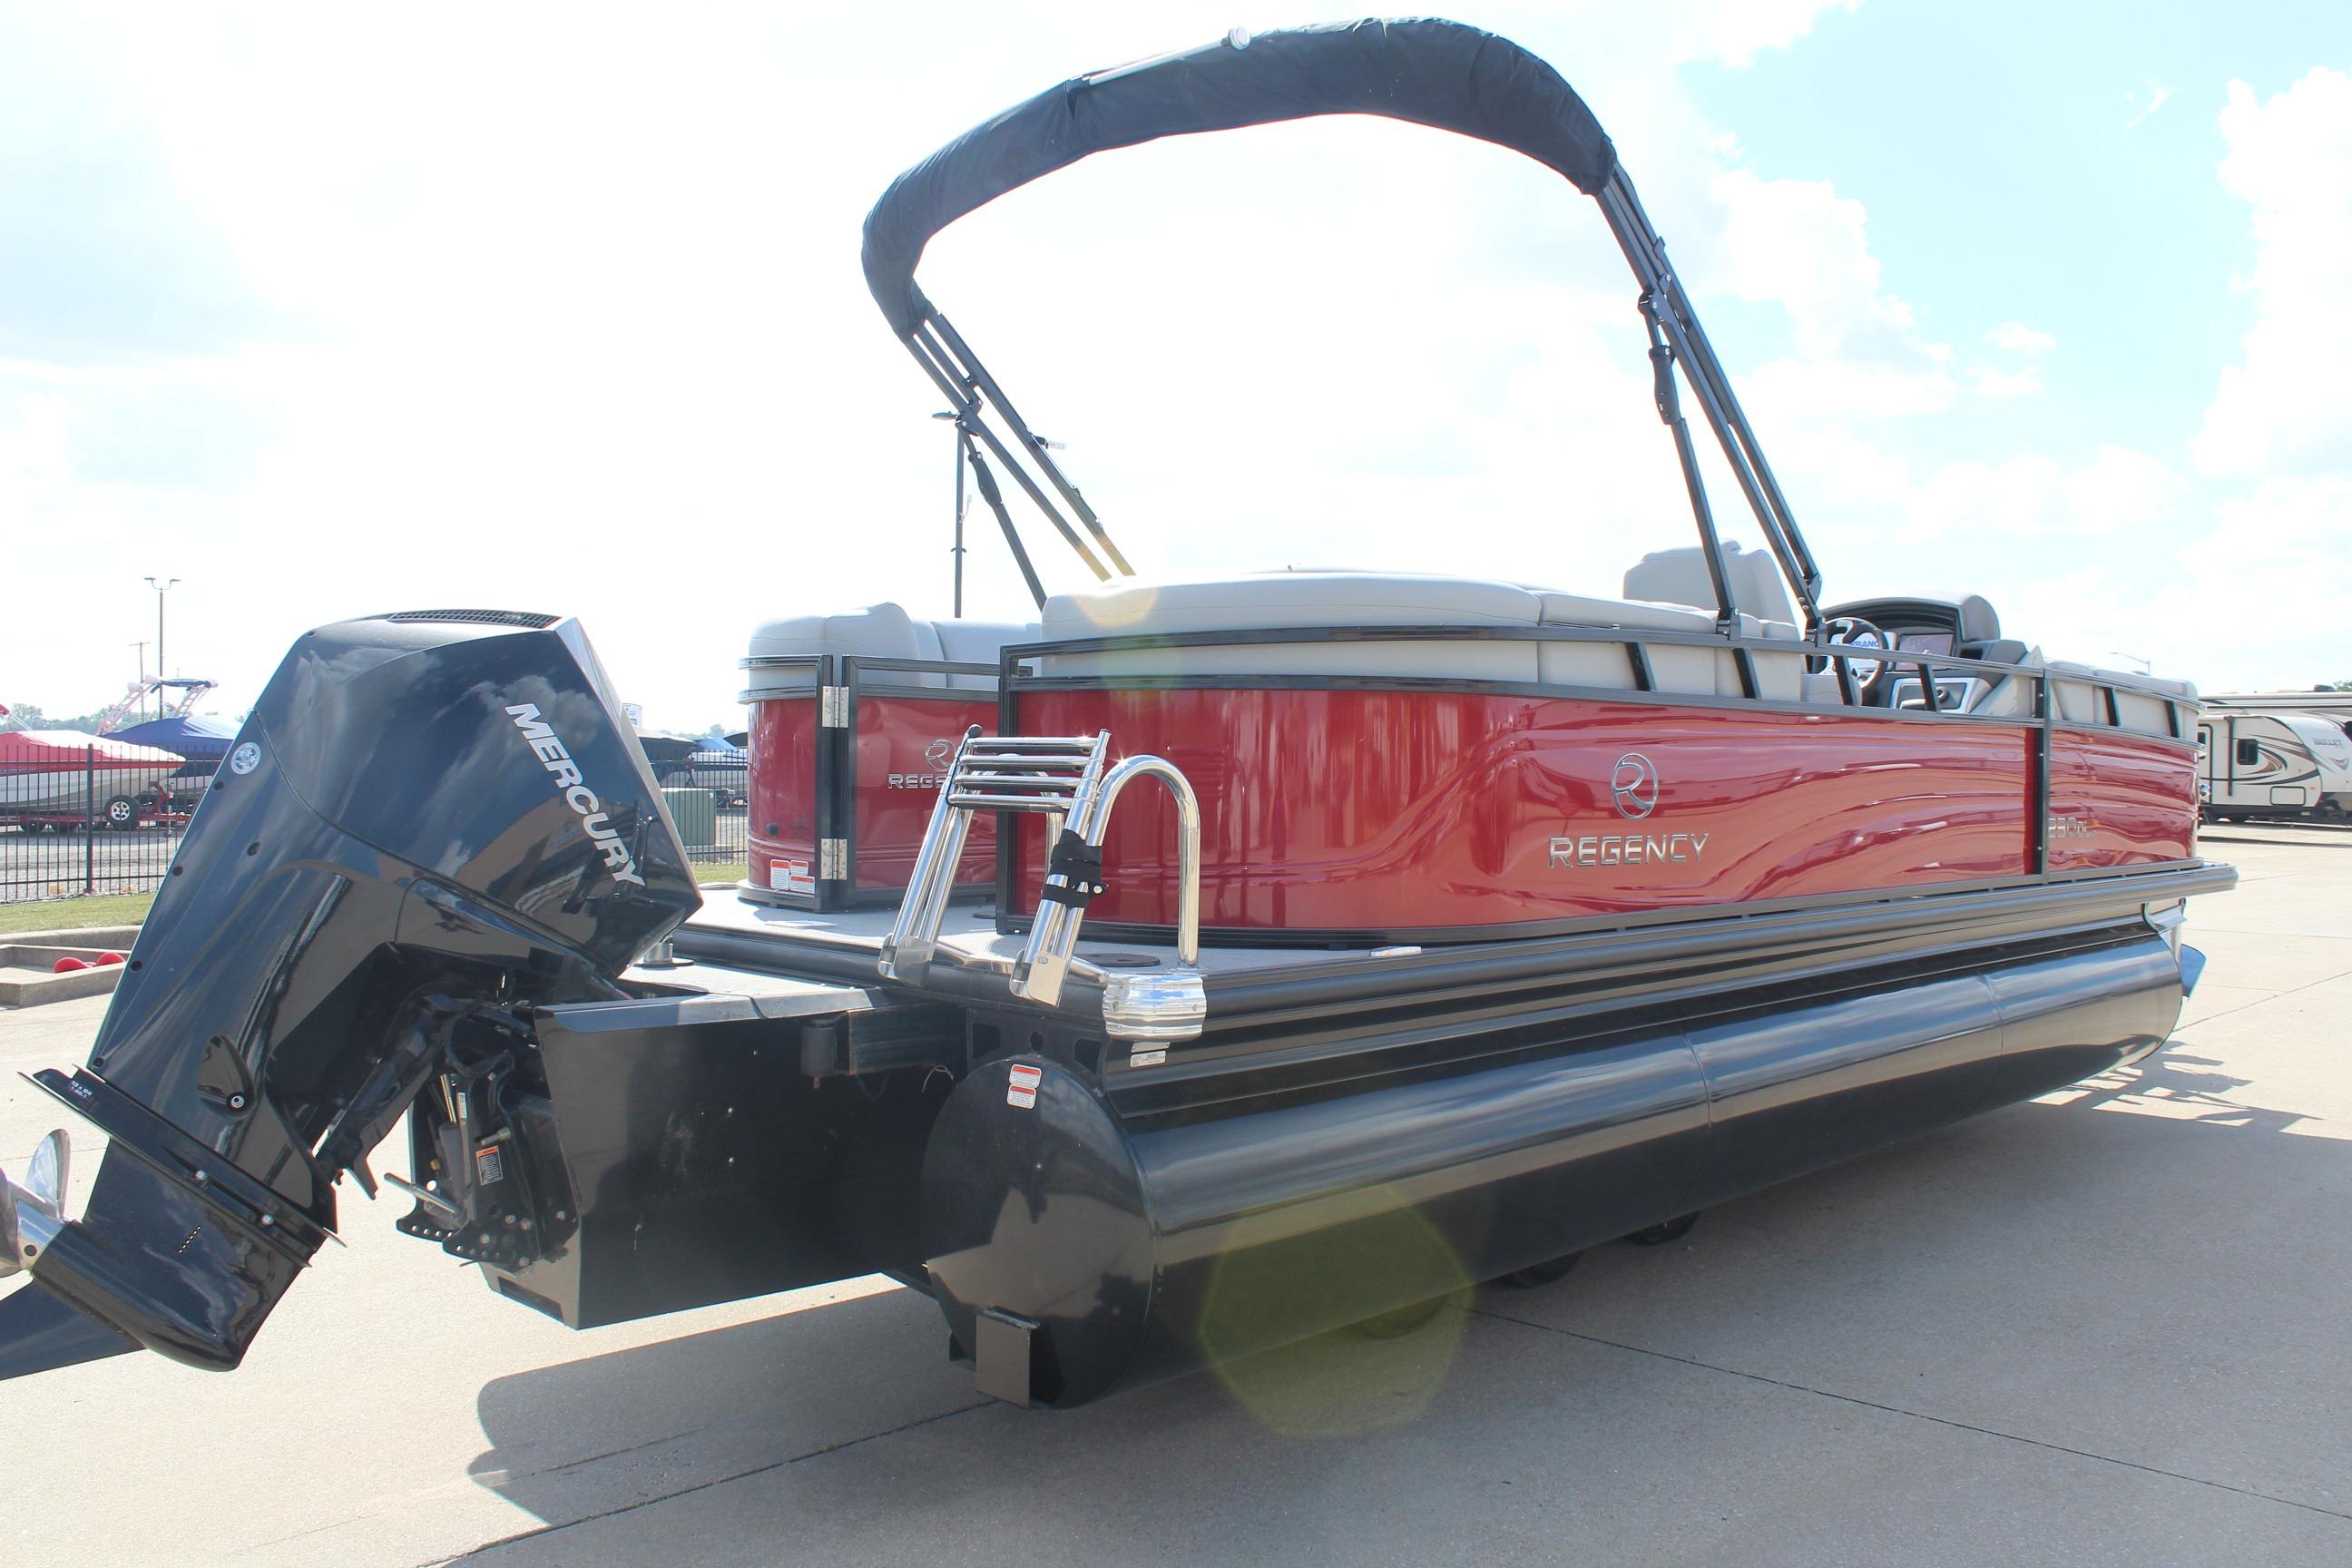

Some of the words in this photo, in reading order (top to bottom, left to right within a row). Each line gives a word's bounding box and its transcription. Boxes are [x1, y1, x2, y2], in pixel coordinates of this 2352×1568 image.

[505, 703, 646, 887] MERCURY
[887, 773, 947, 789] REGE
[1548, 832, 1710, 868] REGENCY
